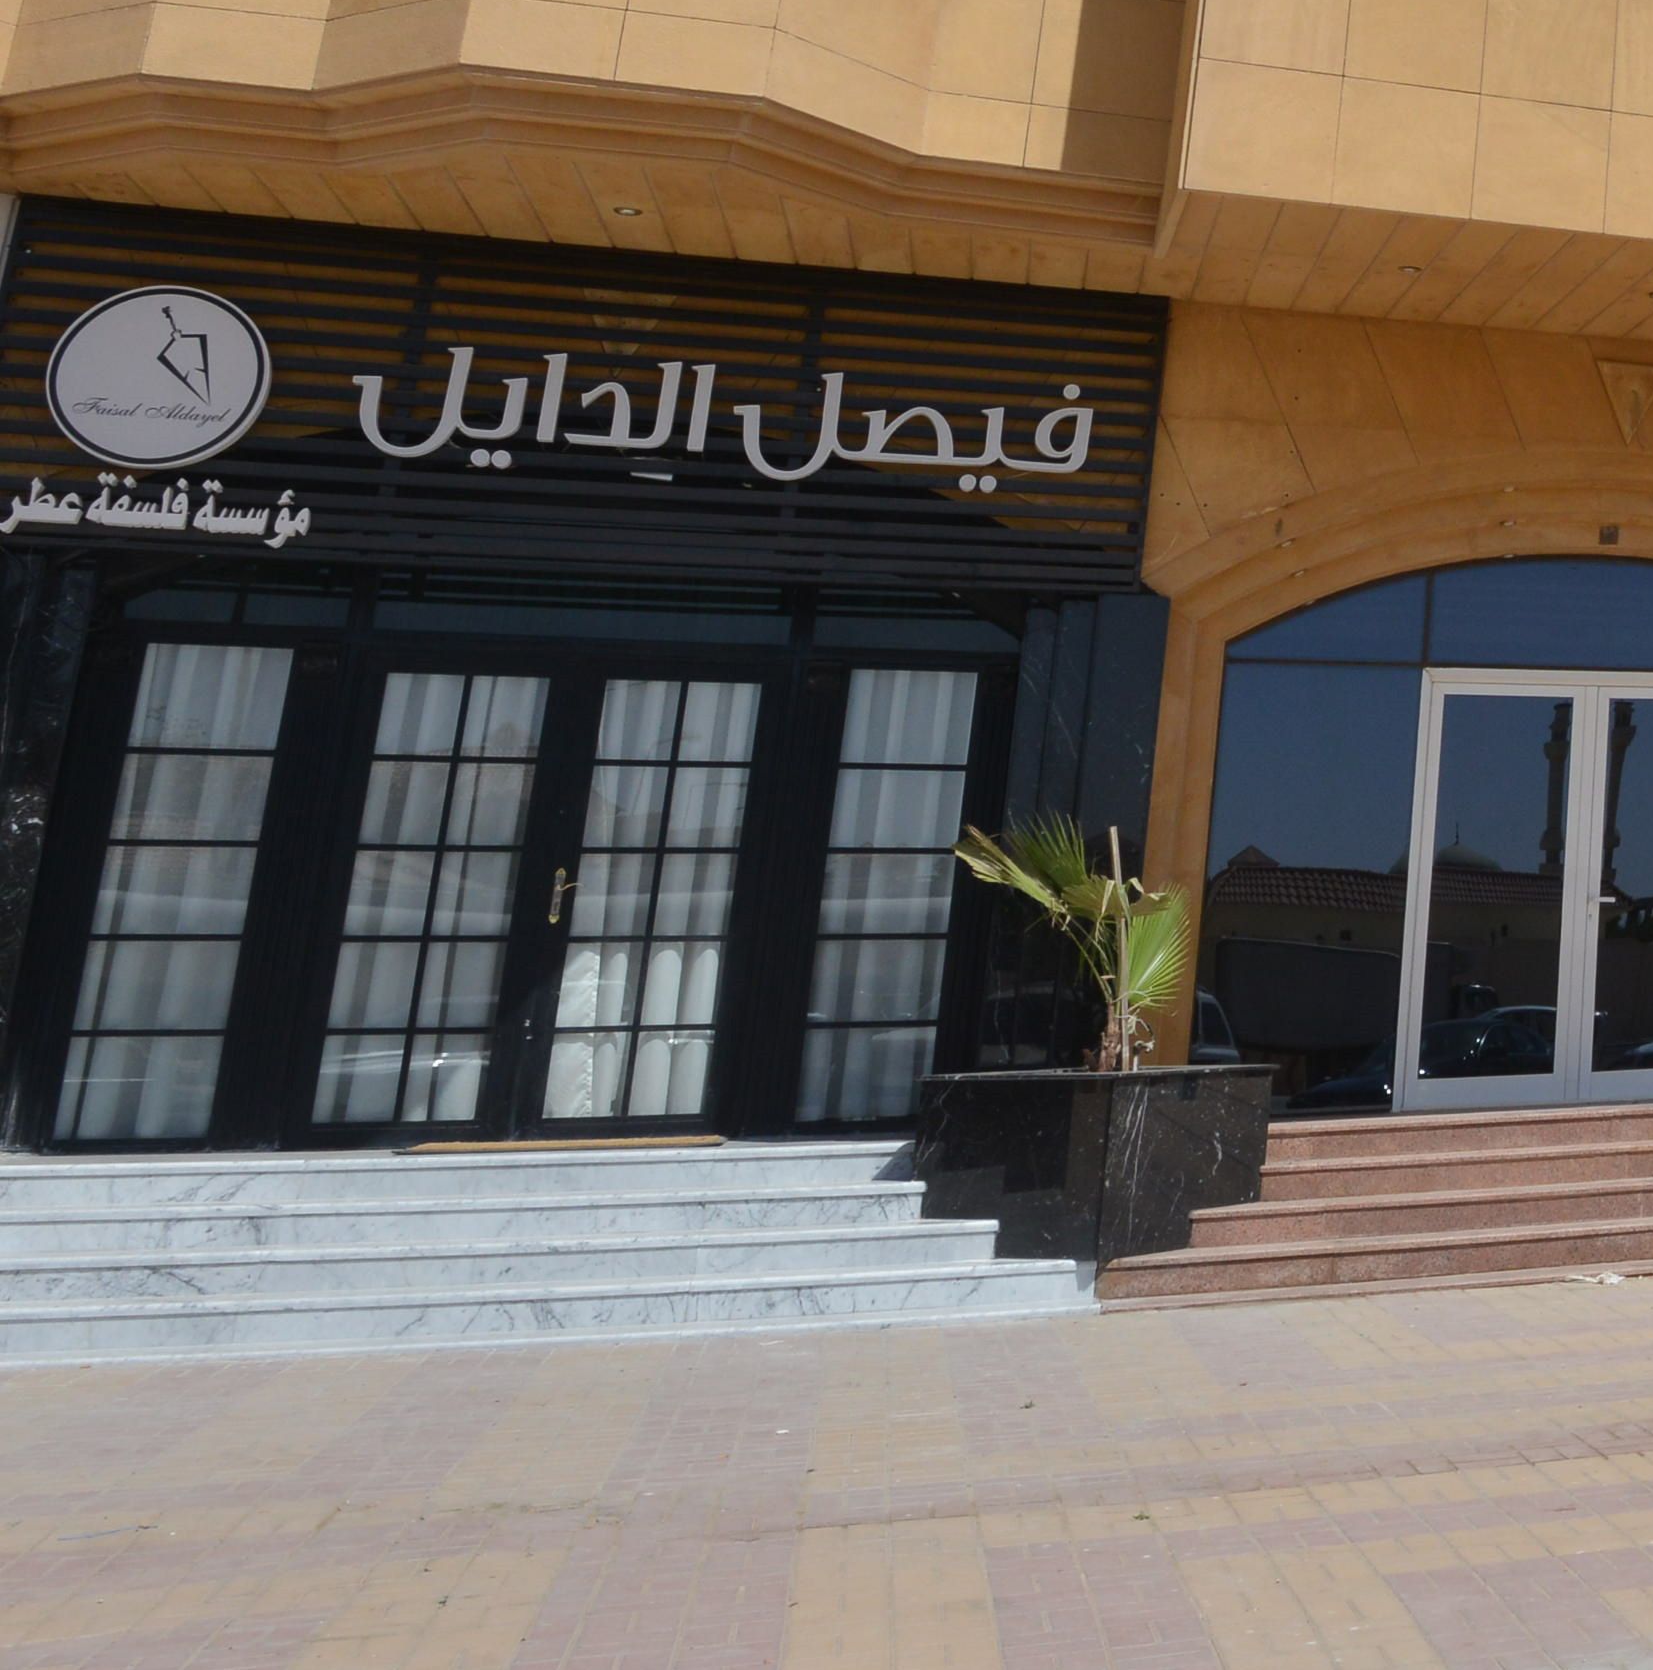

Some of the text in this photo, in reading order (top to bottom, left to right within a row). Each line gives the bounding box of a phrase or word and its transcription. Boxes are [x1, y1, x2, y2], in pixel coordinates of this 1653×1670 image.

[72, 396, 232, 428] Faisal Aldayel
[352, 346, 1094, 493] فيصل الدايل
[0, 471, 312, 549] مؤسسة فلسفة عطر
